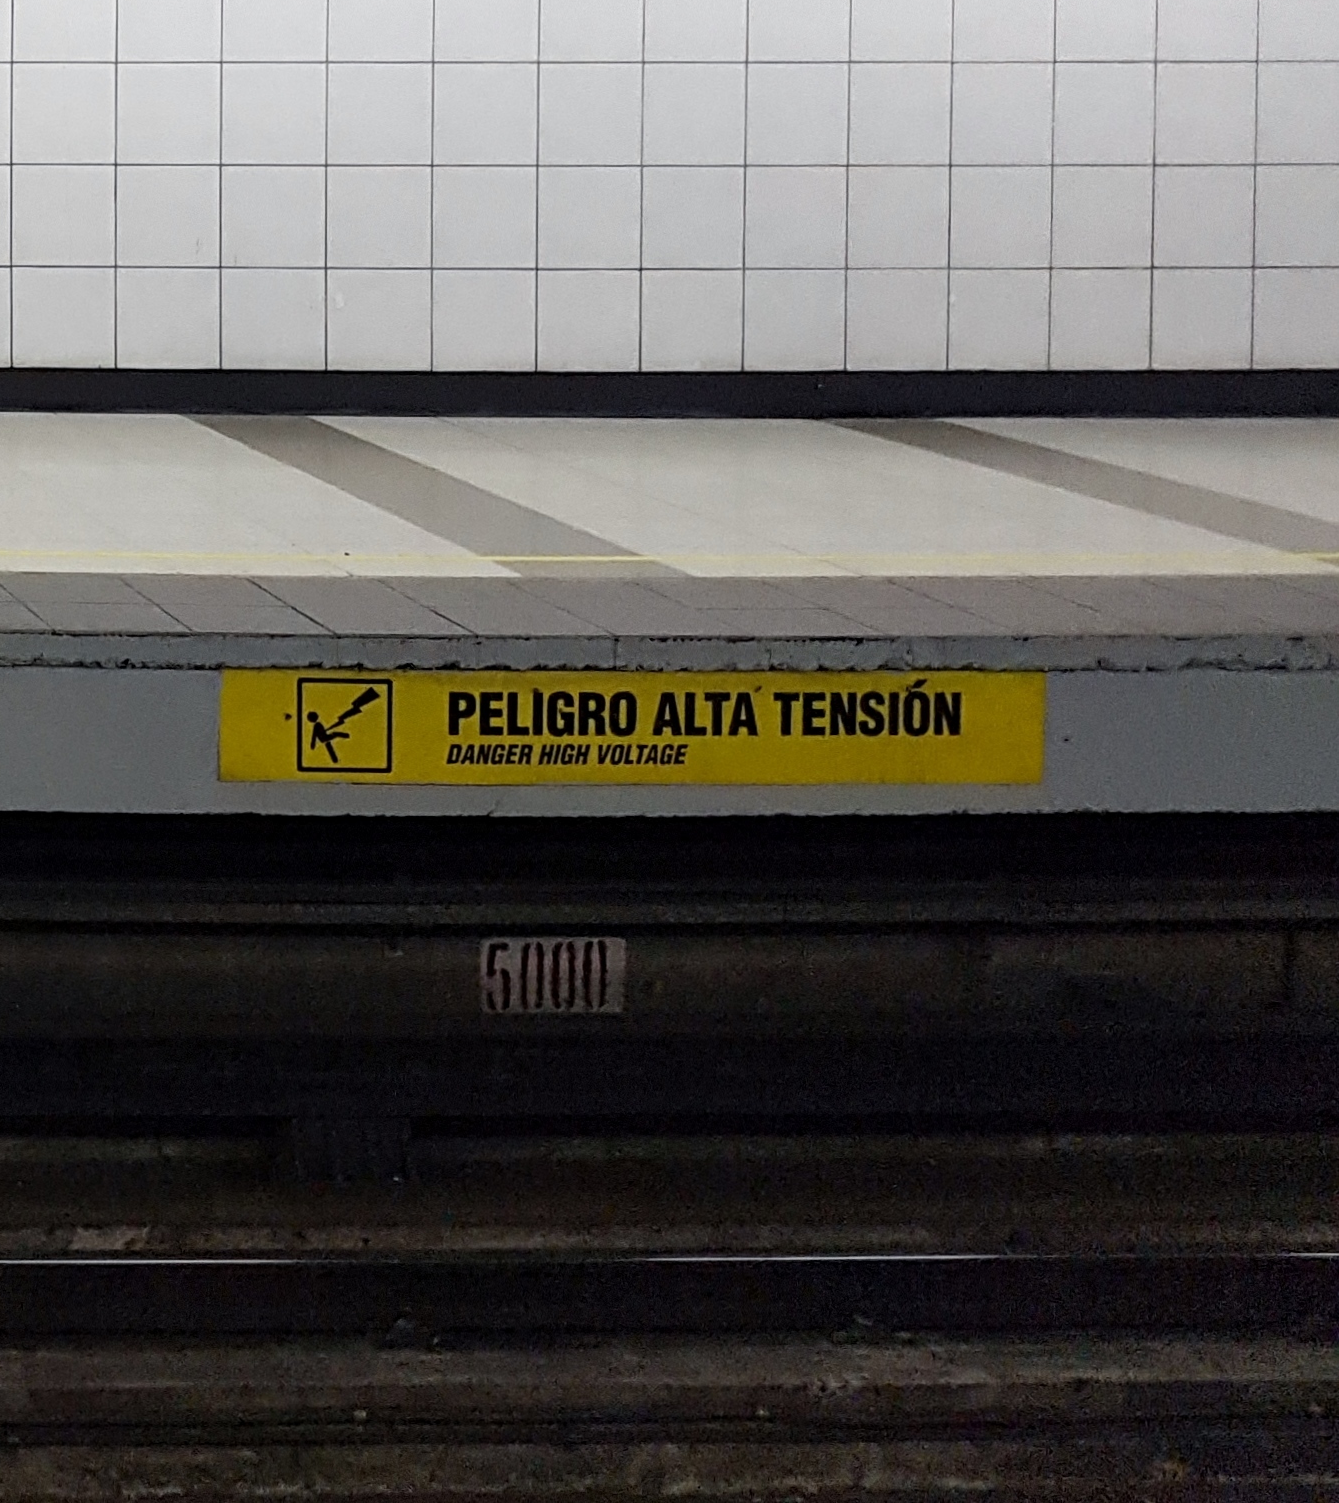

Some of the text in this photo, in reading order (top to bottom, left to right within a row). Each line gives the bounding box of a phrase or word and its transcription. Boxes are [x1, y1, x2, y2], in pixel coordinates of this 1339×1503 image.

[446, 679, 963, 738] PELIGRO ALTA TENSIÓN
[446, 743, 689, 766] DANGER HIGH VOLTAGE
[485, 939, 609, 1011] 5000
